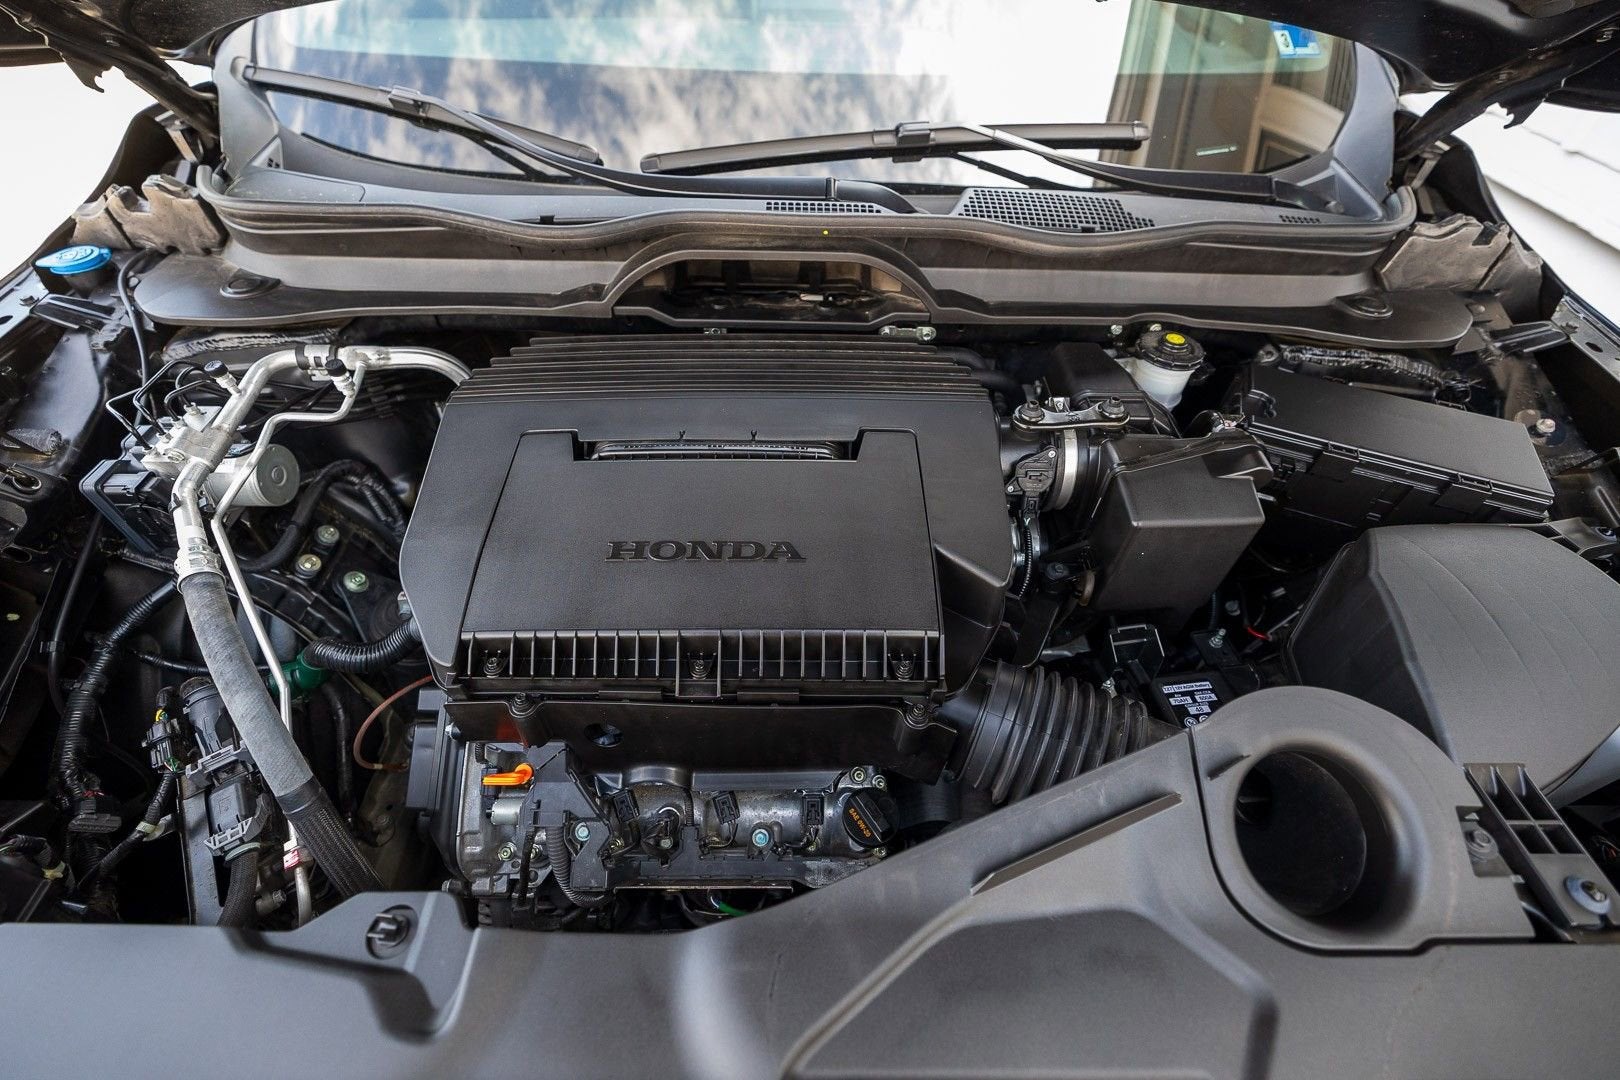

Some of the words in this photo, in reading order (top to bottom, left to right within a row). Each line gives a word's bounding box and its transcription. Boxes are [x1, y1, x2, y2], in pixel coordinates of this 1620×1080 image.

[604, 540, 807, 562] HONDA
[849, 808, 859, 821] SAE
[857, 819, 871, 837] 0W-20
